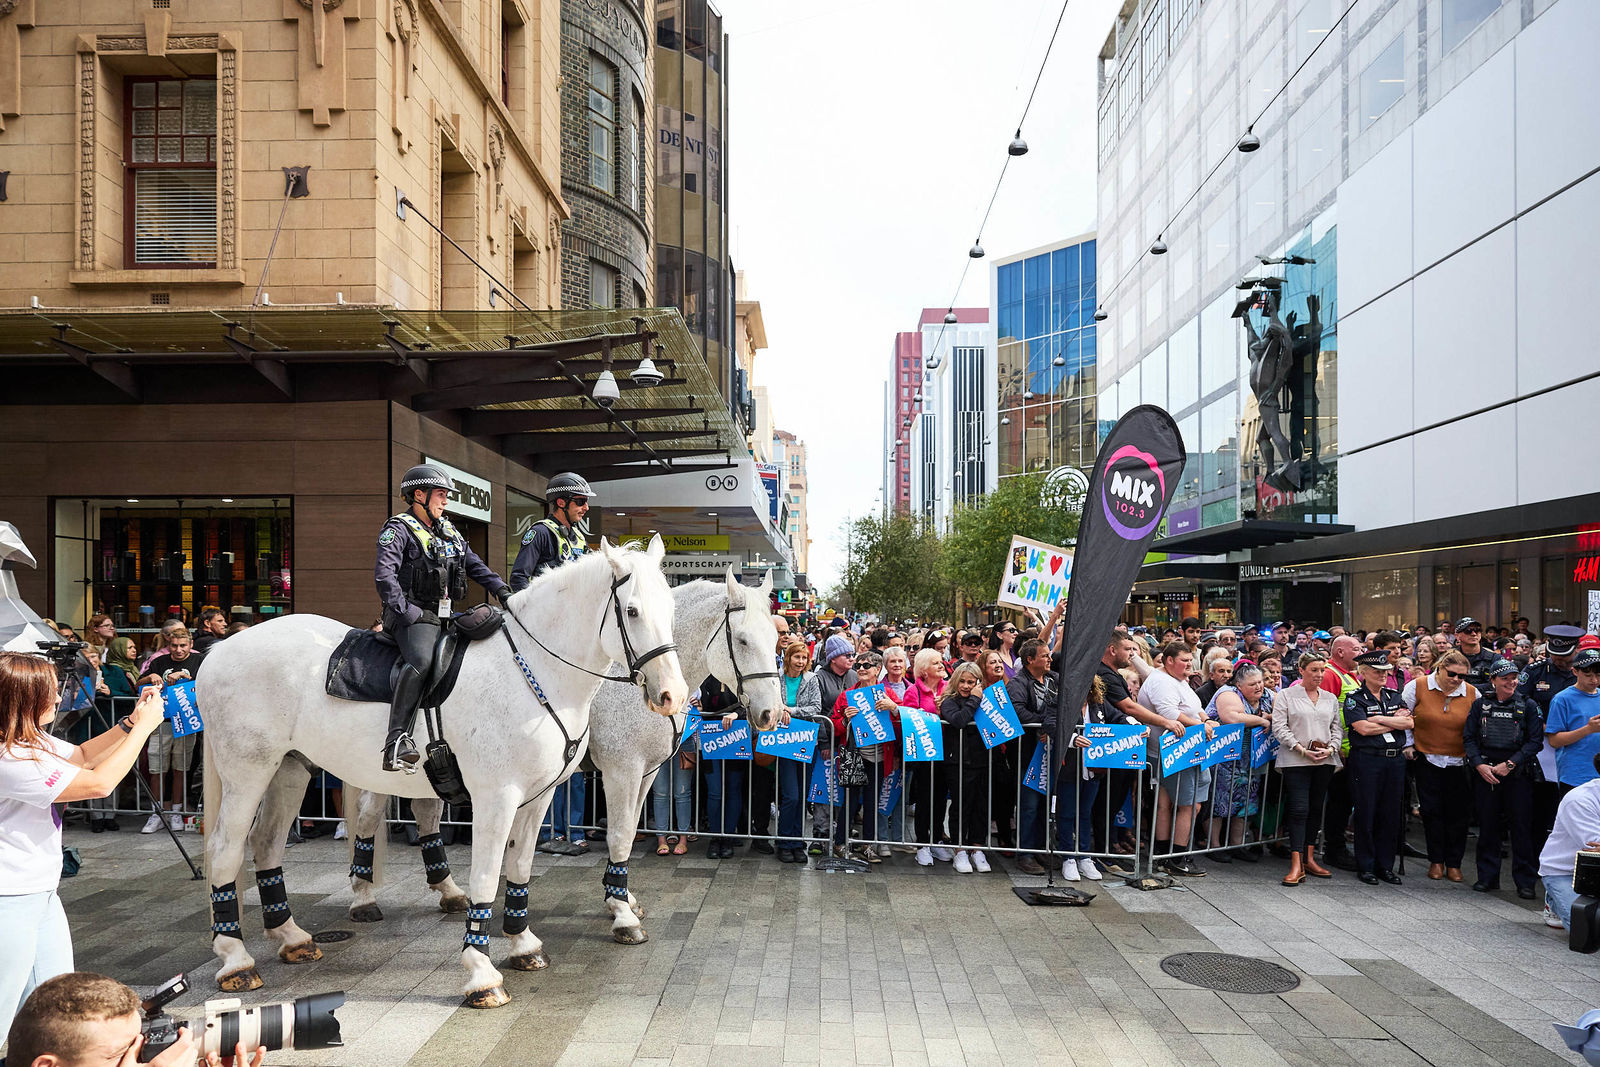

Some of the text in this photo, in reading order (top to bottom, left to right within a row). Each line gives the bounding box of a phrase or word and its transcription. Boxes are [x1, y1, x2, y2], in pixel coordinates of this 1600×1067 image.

[659, 129, 718, 164] DENTST
[1110, 470, 1156, 508] MIX
[1116, 500, 1145, 519] 102.3
[673, 537, 706, 546] Nelson
[1028, 548, 1047, 573] WE
[1240, 565, 1270, 577] RUNDLE
[1573, 556, 1600, 583] H&M
[853, 691, 871, 716] OUR
[864, 711, 887, 741] HERO
[988, 709, 1015, 738] HERO
[703, 727, 748, 753] GO SAMMY
[761, 729, 815, 746] GO SAMMY
[1087, 745, 1104, 760] GO
[1104, 734, 1143, 755] SAMMY
[1163, 753, 1175, 769] GO
[1173, 731, 1204, 760] SAMMY
[1210, 729, 1241, 754] SAMMY
[44, 769, 63, 788] MIX
